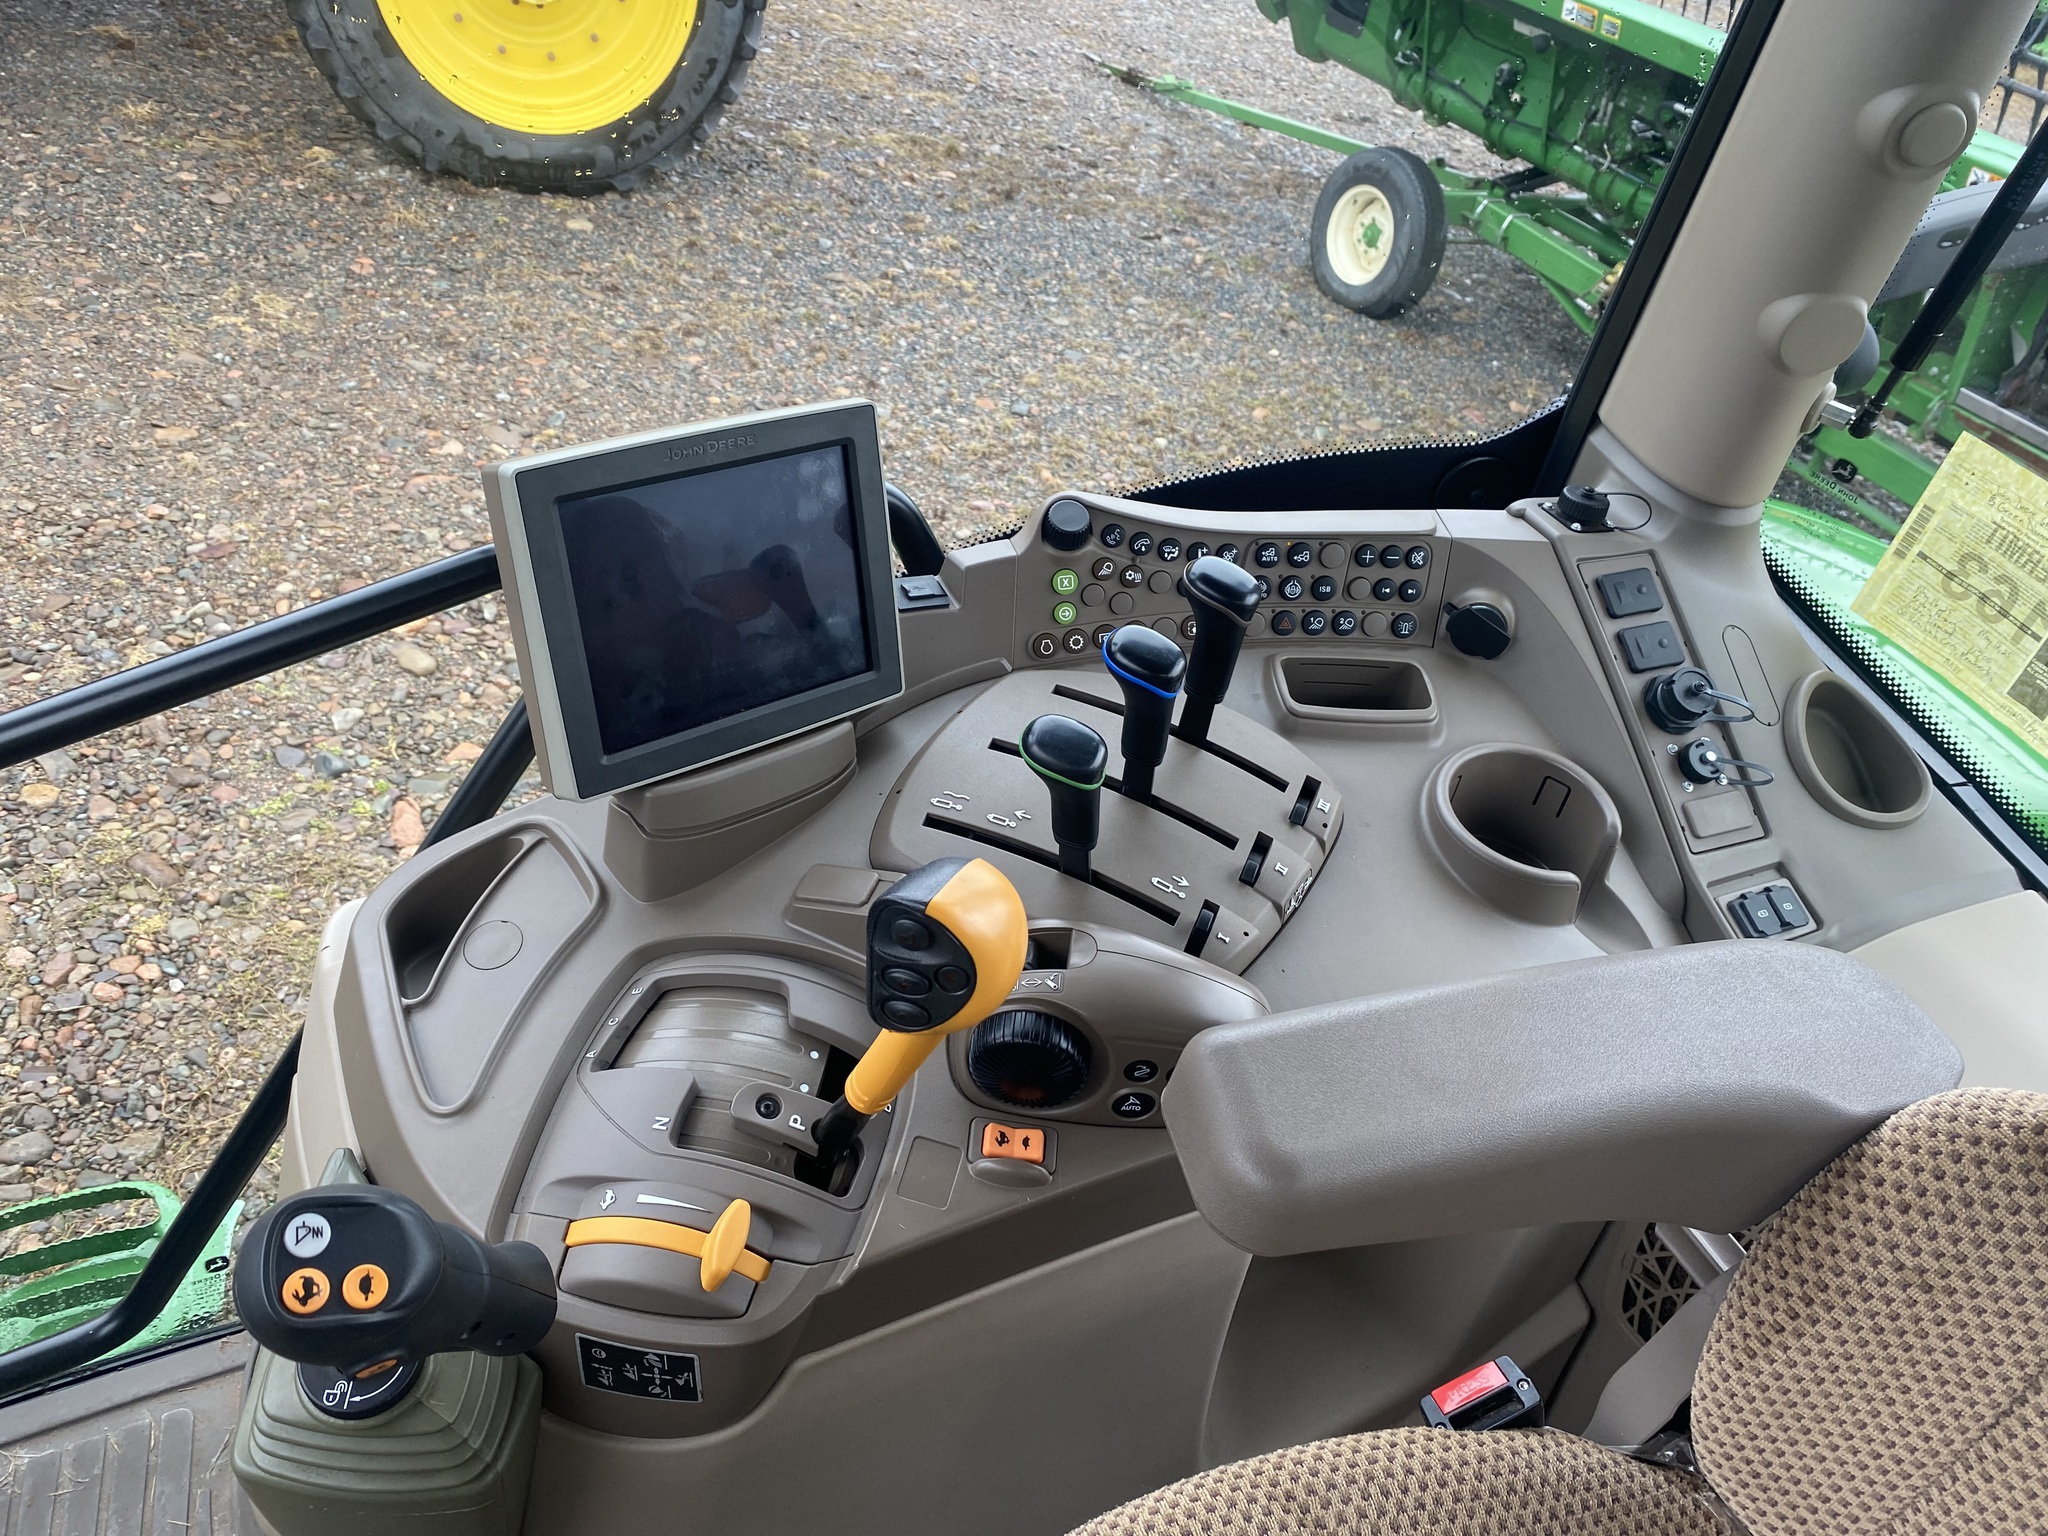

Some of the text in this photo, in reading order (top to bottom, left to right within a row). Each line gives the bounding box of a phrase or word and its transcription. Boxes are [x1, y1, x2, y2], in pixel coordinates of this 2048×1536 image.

[664, 434, 757, 462] JOHN DEERE
[631, 986, 643, 995] E
[608, 1016, 620, 1027] C
[586, 1049, 597, 1059] A
[1120, 1102, 1142, 1111] AUTO
[652, 1116, 671, 1131] N
[788, 1114, 807, 1131] P
[1448, 1373, 1490, 1401] PRESS
